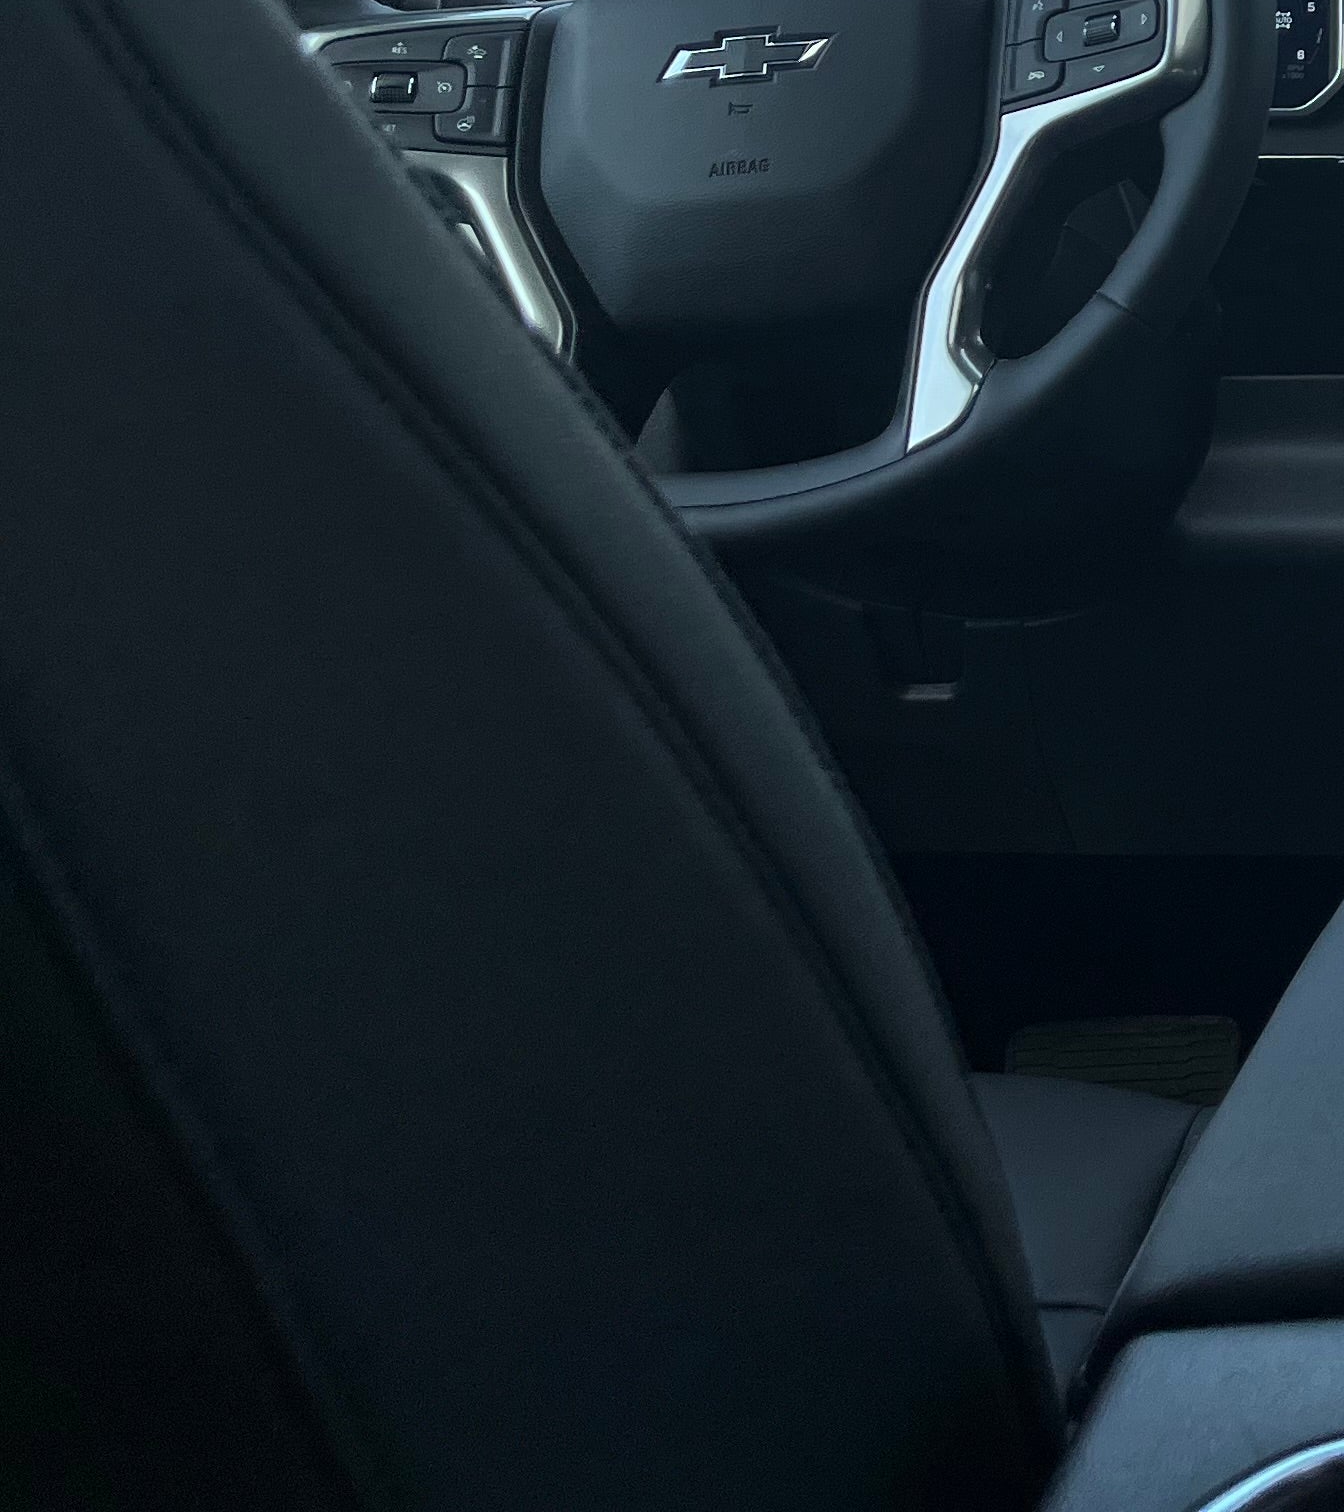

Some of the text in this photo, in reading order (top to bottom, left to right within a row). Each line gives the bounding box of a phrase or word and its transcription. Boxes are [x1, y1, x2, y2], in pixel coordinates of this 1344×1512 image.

[1307, 2, 1316, 12] 5
[391, 46, 408, 55] RES
[708, 158, 770, 178] AIRBAG
